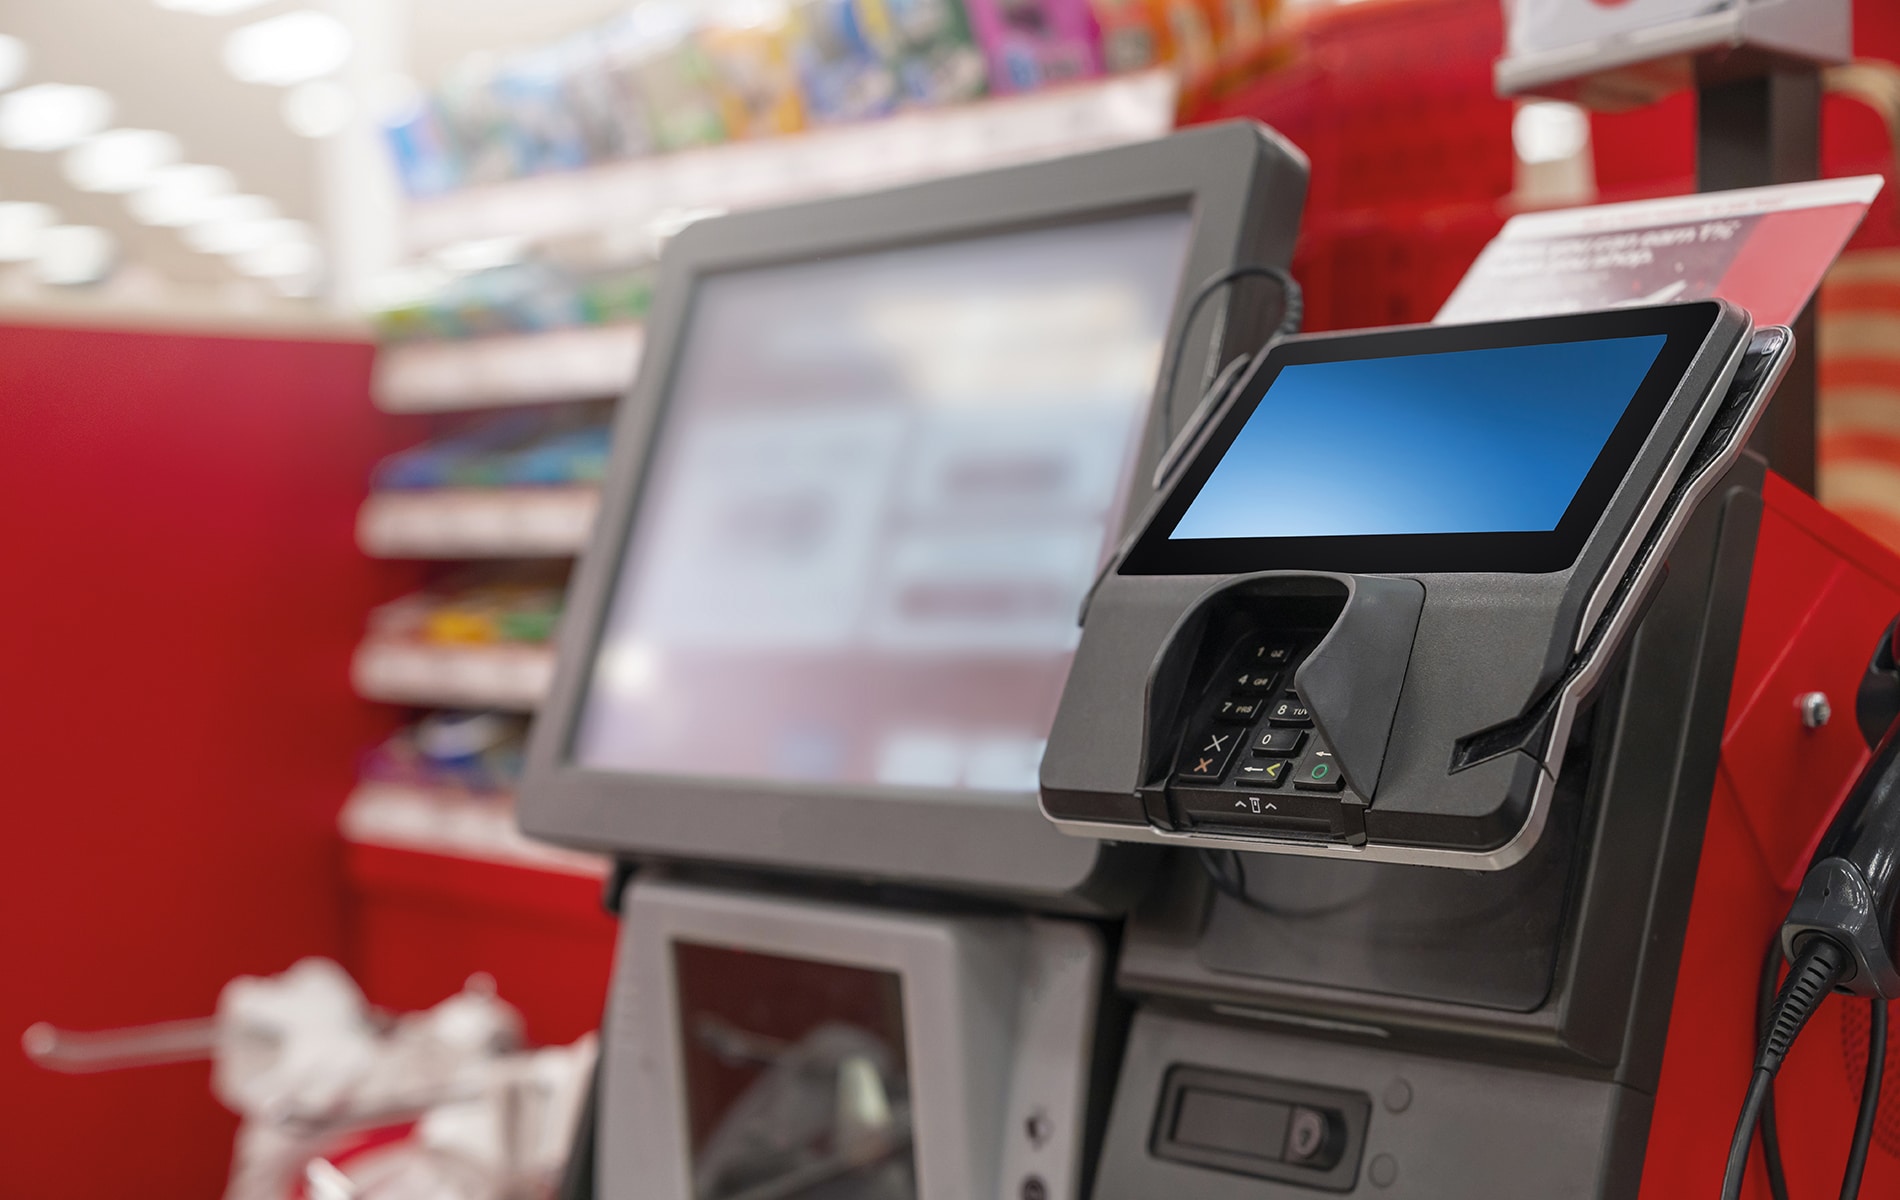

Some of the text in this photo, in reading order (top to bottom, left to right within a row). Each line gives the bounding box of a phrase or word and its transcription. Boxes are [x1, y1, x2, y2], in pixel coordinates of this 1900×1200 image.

[1257, 647, 1265, 657] 1
[1238, 674, 1249, 685] 4
[1222, 702, 1233, 713] 7
[1277, 704, 1288, 715] 8
